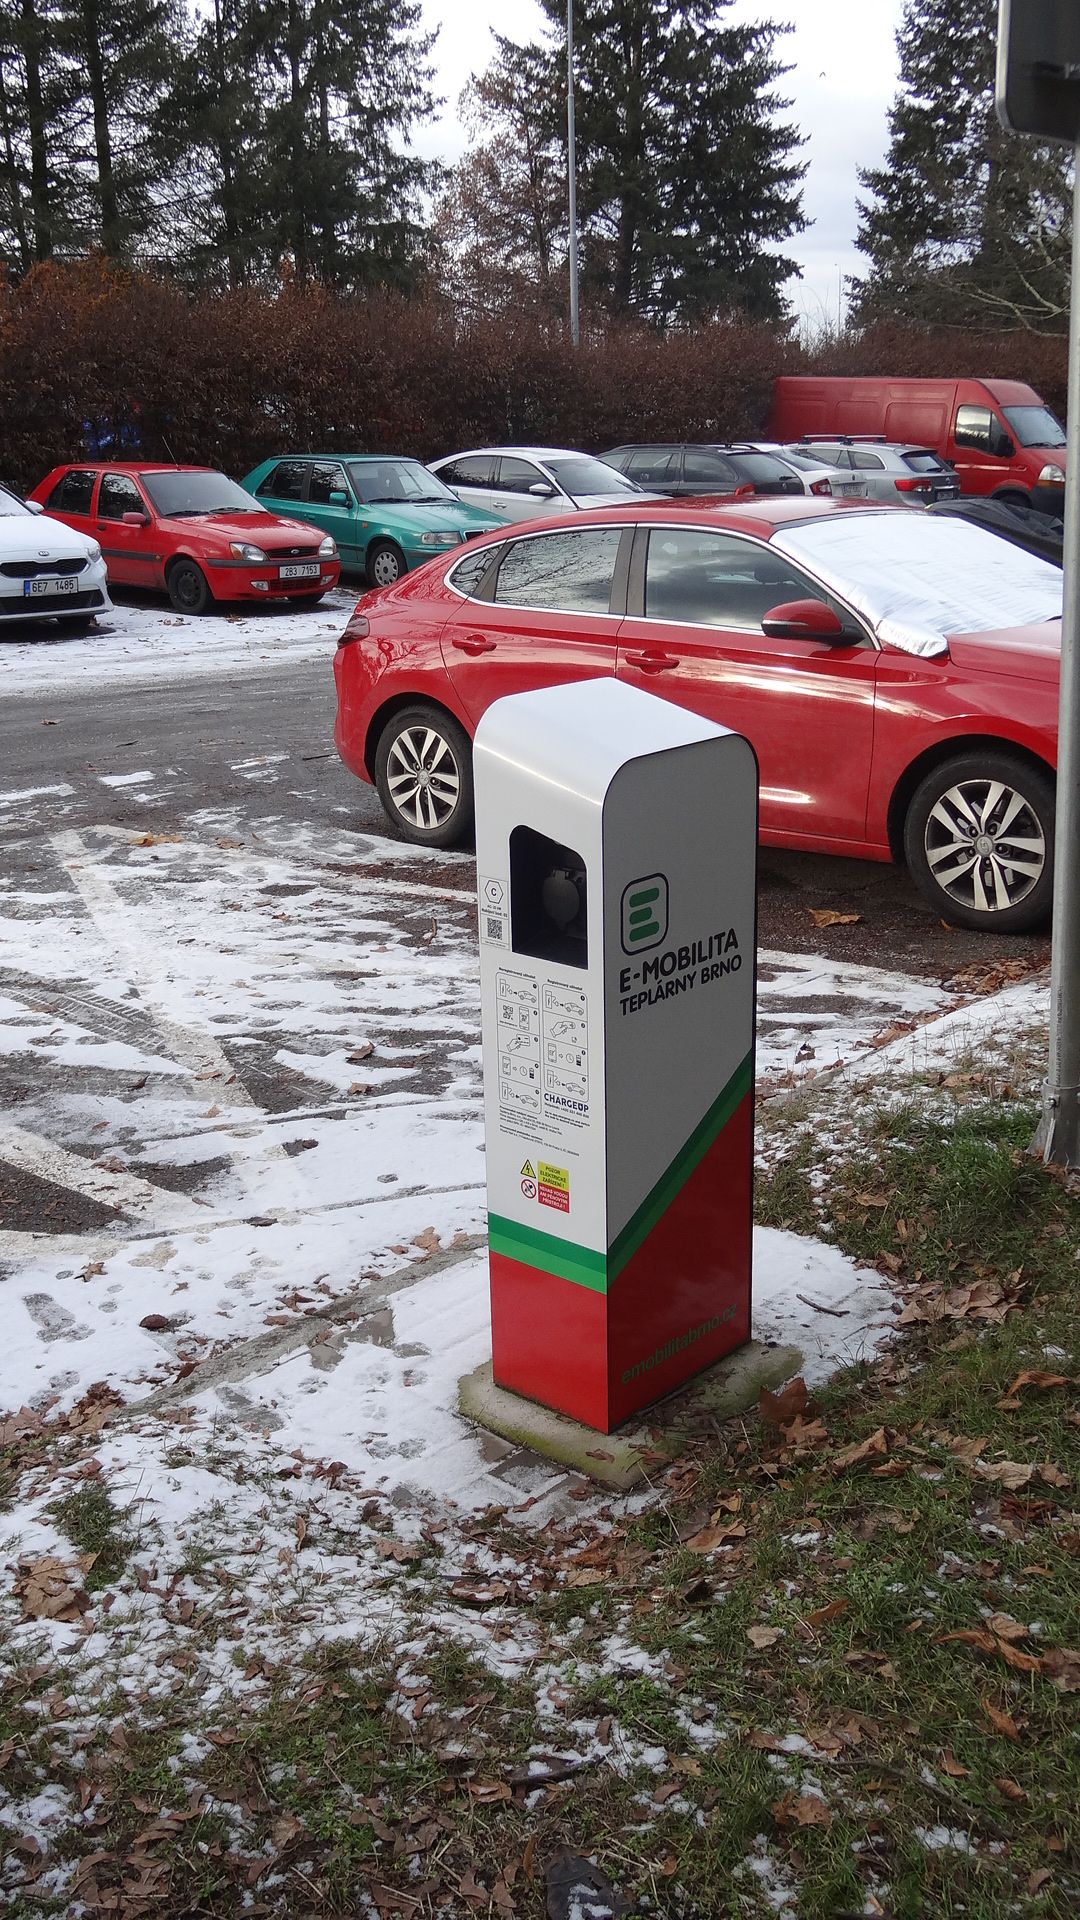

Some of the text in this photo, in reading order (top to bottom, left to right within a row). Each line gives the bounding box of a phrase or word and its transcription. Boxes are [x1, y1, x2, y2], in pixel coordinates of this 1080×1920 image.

[32, 579, 74, 593] 6E7 1485
[285, 565, 318, 577] 2B3 7153
[490, 887, 497, 897] C
[619, 928, 739, 993] E-MOBILITA
[619, 954, 742, 1016] TEPLÁRNY BRNO
[621, 1303, 737, 1385] emobilitabrno.cz
